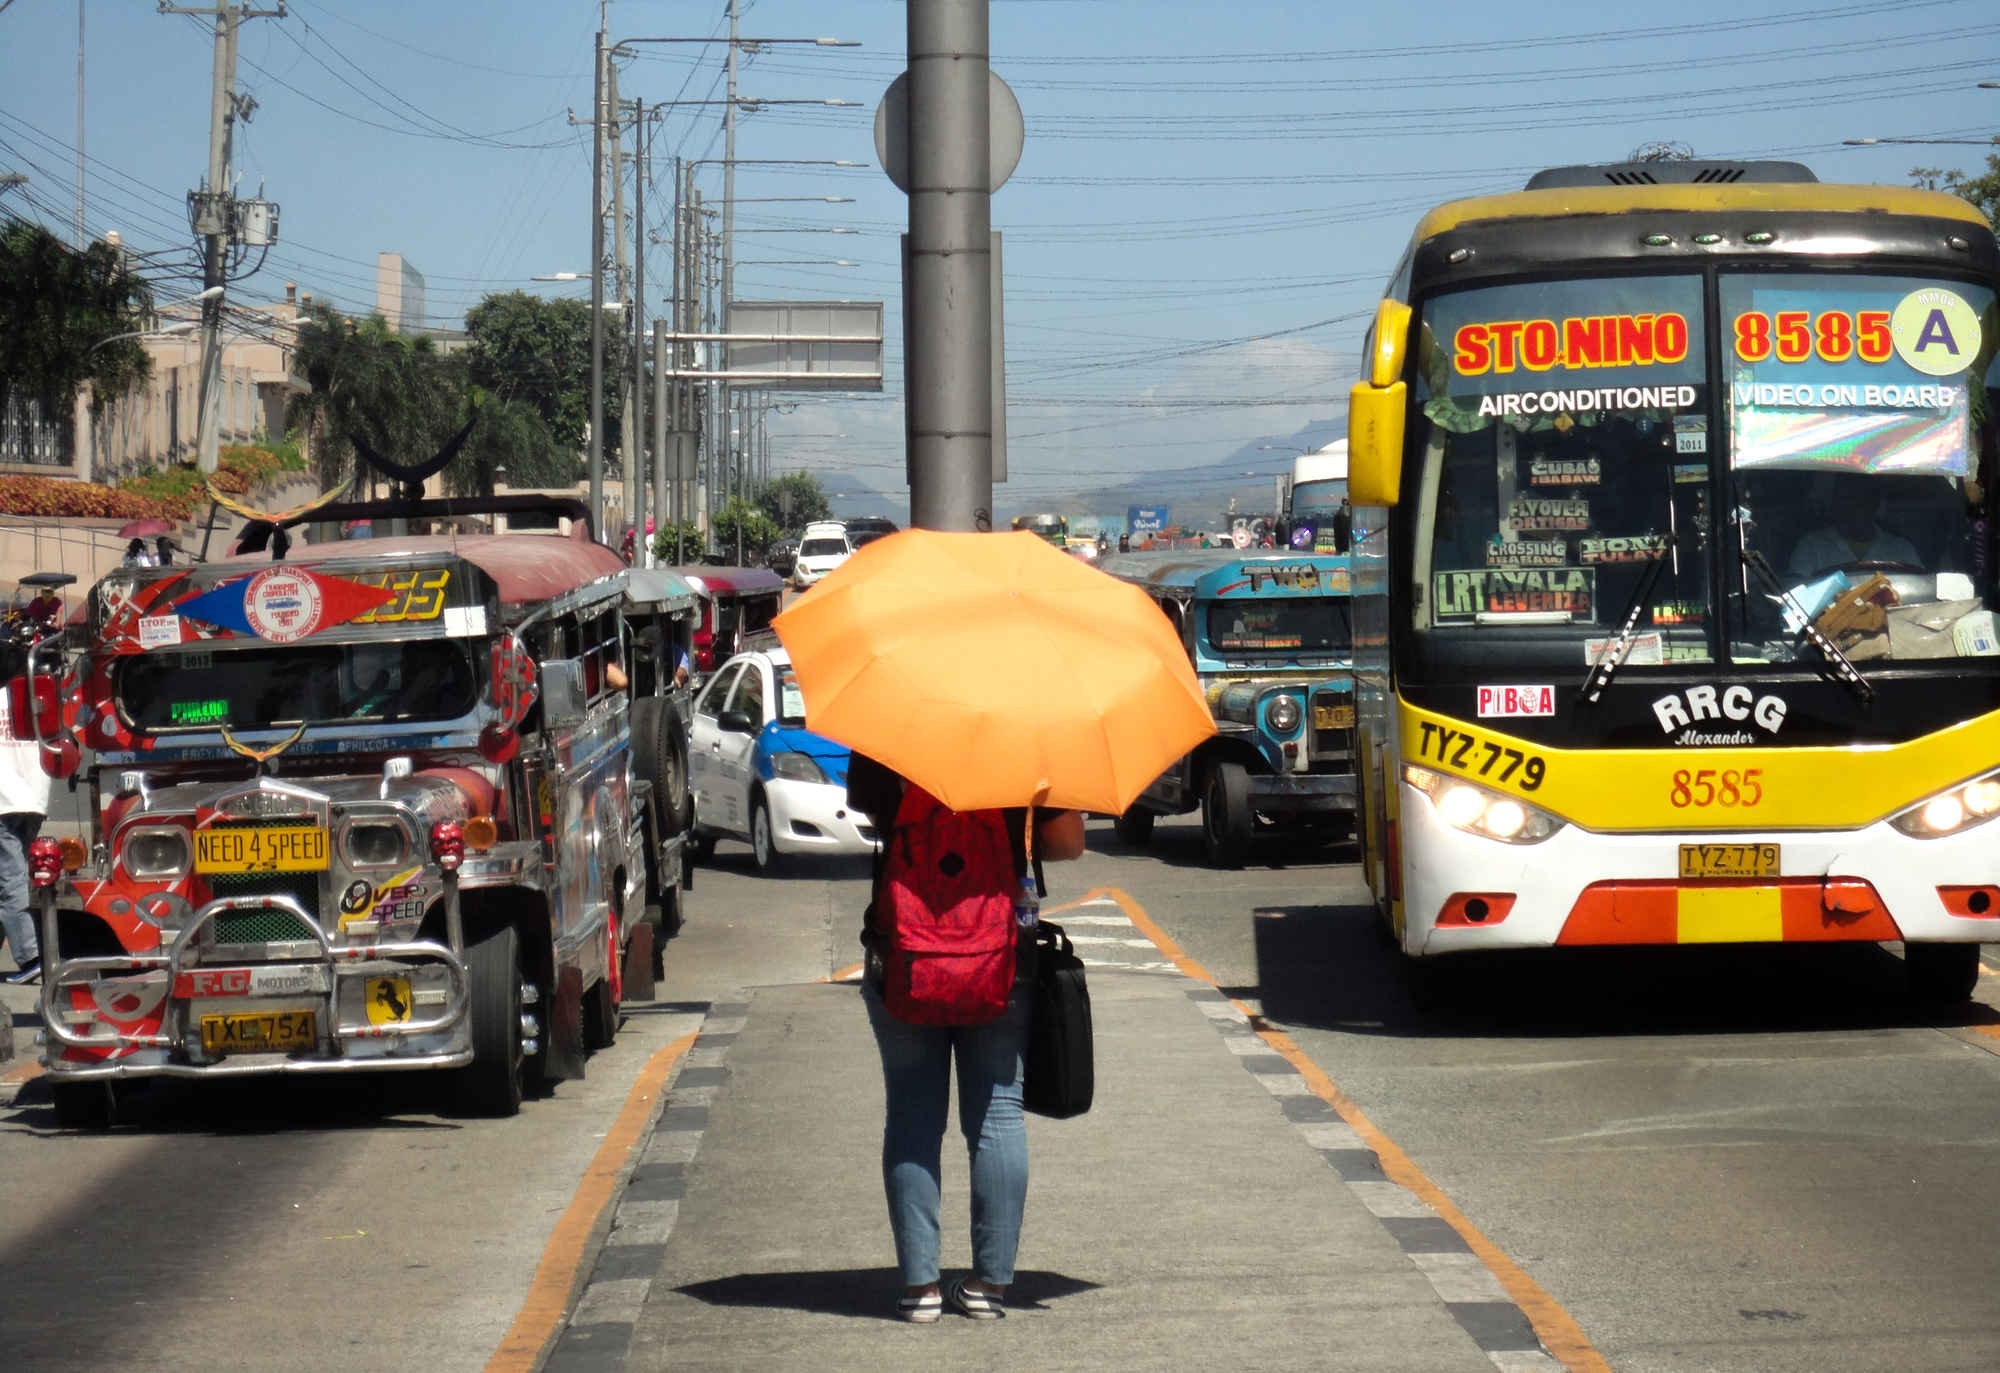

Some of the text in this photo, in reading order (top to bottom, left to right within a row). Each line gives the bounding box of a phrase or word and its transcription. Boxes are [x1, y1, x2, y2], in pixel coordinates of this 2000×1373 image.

[1734, 311, 1894, 363] 8585
[1914, 309, 1960, 355] A
[1478, 386, 1696, 417] AIRCONDITIONED
[1736, 385, 1956, 407] VIDEO ON BOARD
[1680, 439, 1703, 450] 2011
[1531, 461, 1600, 475] CUBAO
[1510, 500, 1588, 517] FLYOVER
[1489, 542, 1566, 556] CROSSING
[1438, 574, 1486, 612] LRT
[1489, 571, 1589, 592] AYALA
[1652, 685, 1787, 734] RRCG
[1675, 729, 1755, 746] Alexander
[1671, 769, 1763, 808] 8585
[198, 832, 324, 862] NEED 4 SPEED
[341, 880, 418, 914] OVER
[370, 900, 424, 924] SPEED
[257, 975, 309, 990] MOTORS
